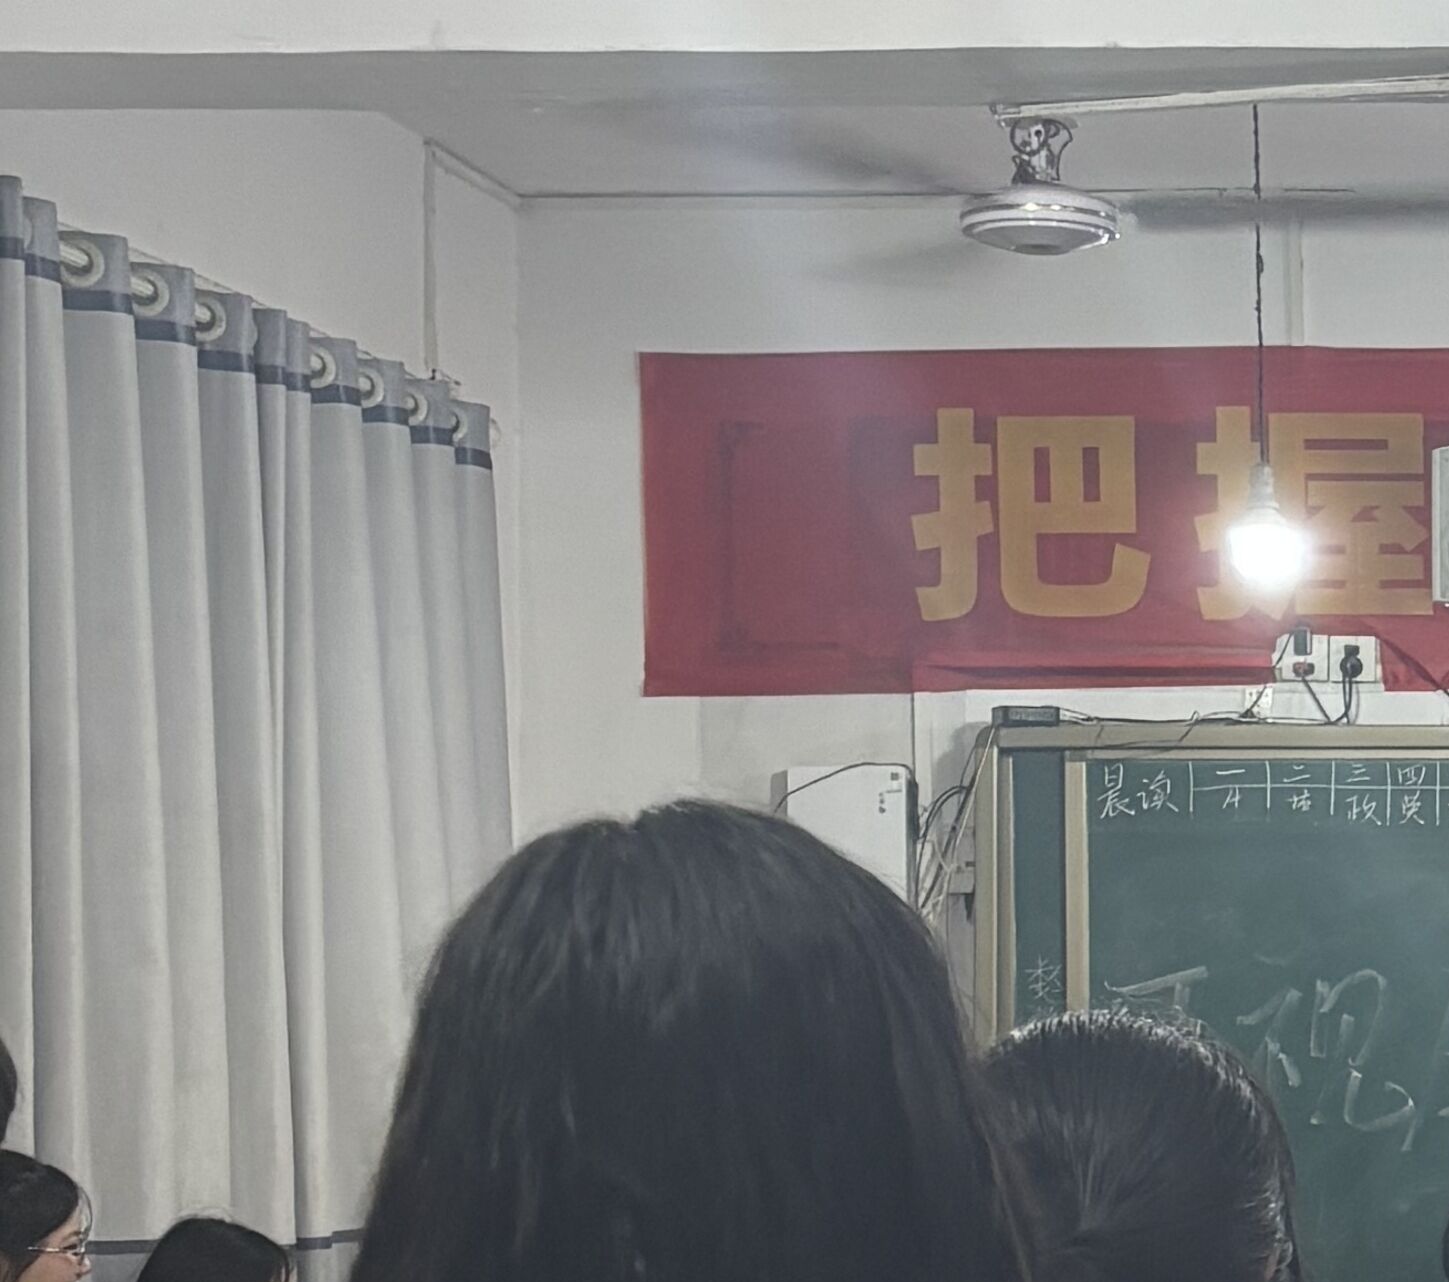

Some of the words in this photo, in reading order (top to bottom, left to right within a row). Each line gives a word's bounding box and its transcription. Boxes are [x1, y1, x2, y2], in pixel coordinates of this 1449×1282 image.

[1096, 763, 1181, 820] 晨读
[1215, 769, 1247, 777] 一
[1282, 764, 1313, 784] 二
[1346, 763, 1372, 783] 三
[1396, 763, 1427, 786] 四
